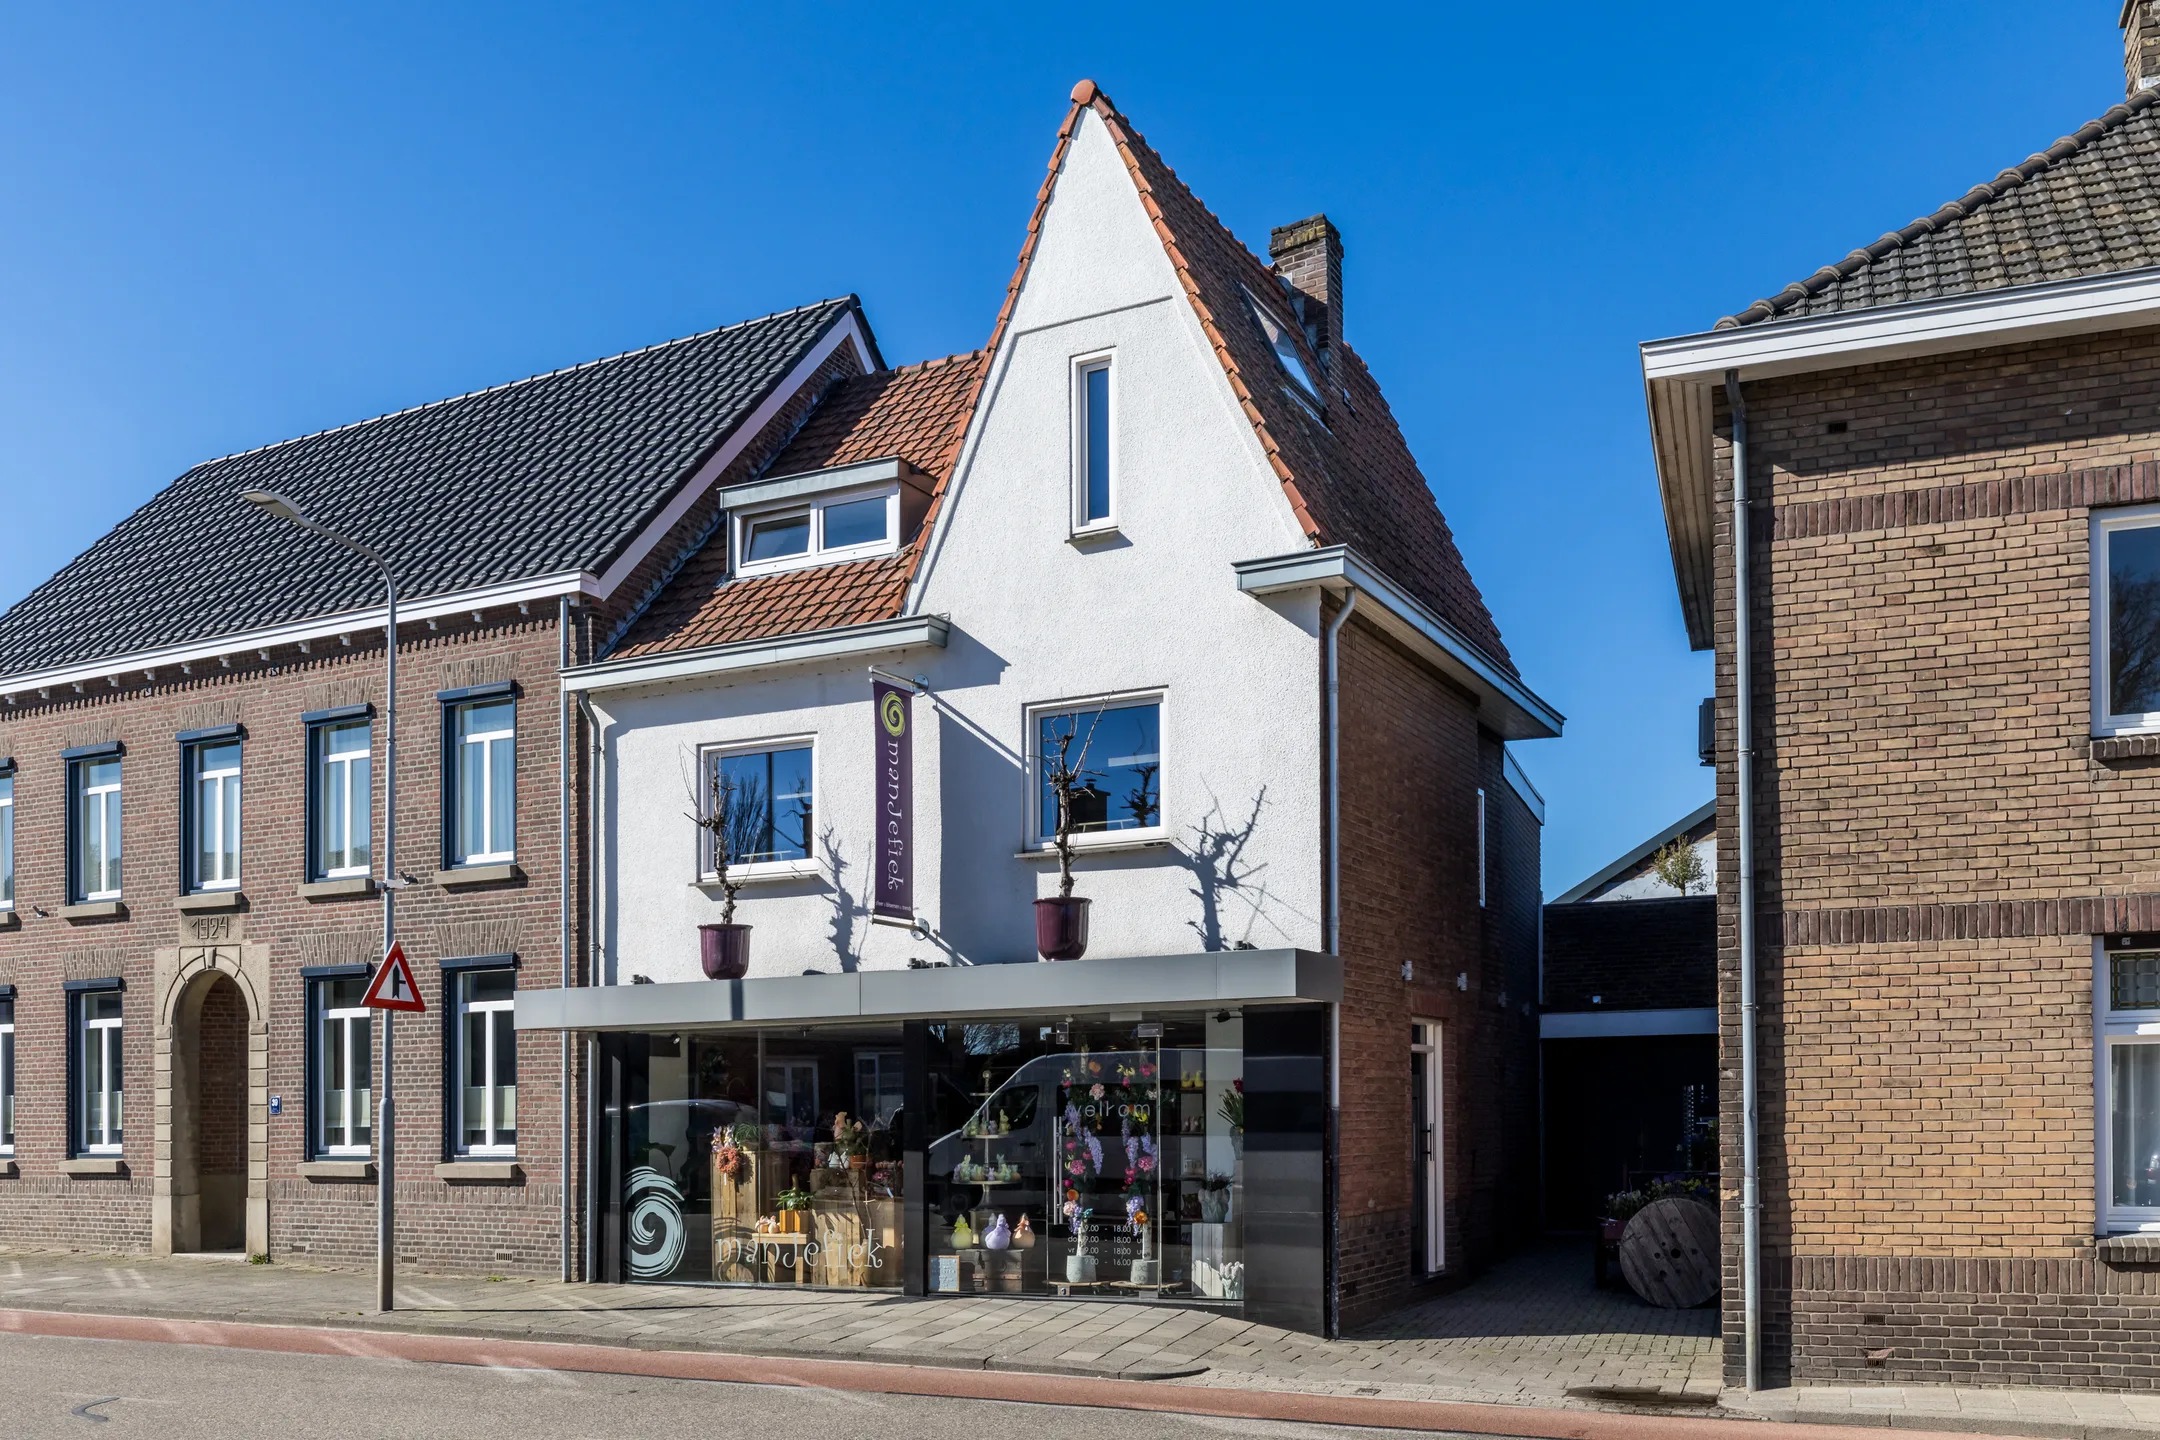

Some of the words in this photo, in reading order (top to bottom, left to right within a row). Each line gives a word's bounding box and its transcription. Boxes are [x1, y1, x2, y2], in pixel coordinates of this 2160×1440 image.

[191, 915, 229, 940] 1924
[1113, 1224, 1132, 1232] 18.00
[1113, 1236, 1132, 1244] 18.00
[1113, 1247, 1132, 1255] 18.00
[1113, 1258, 1132, 1266] 16.00
